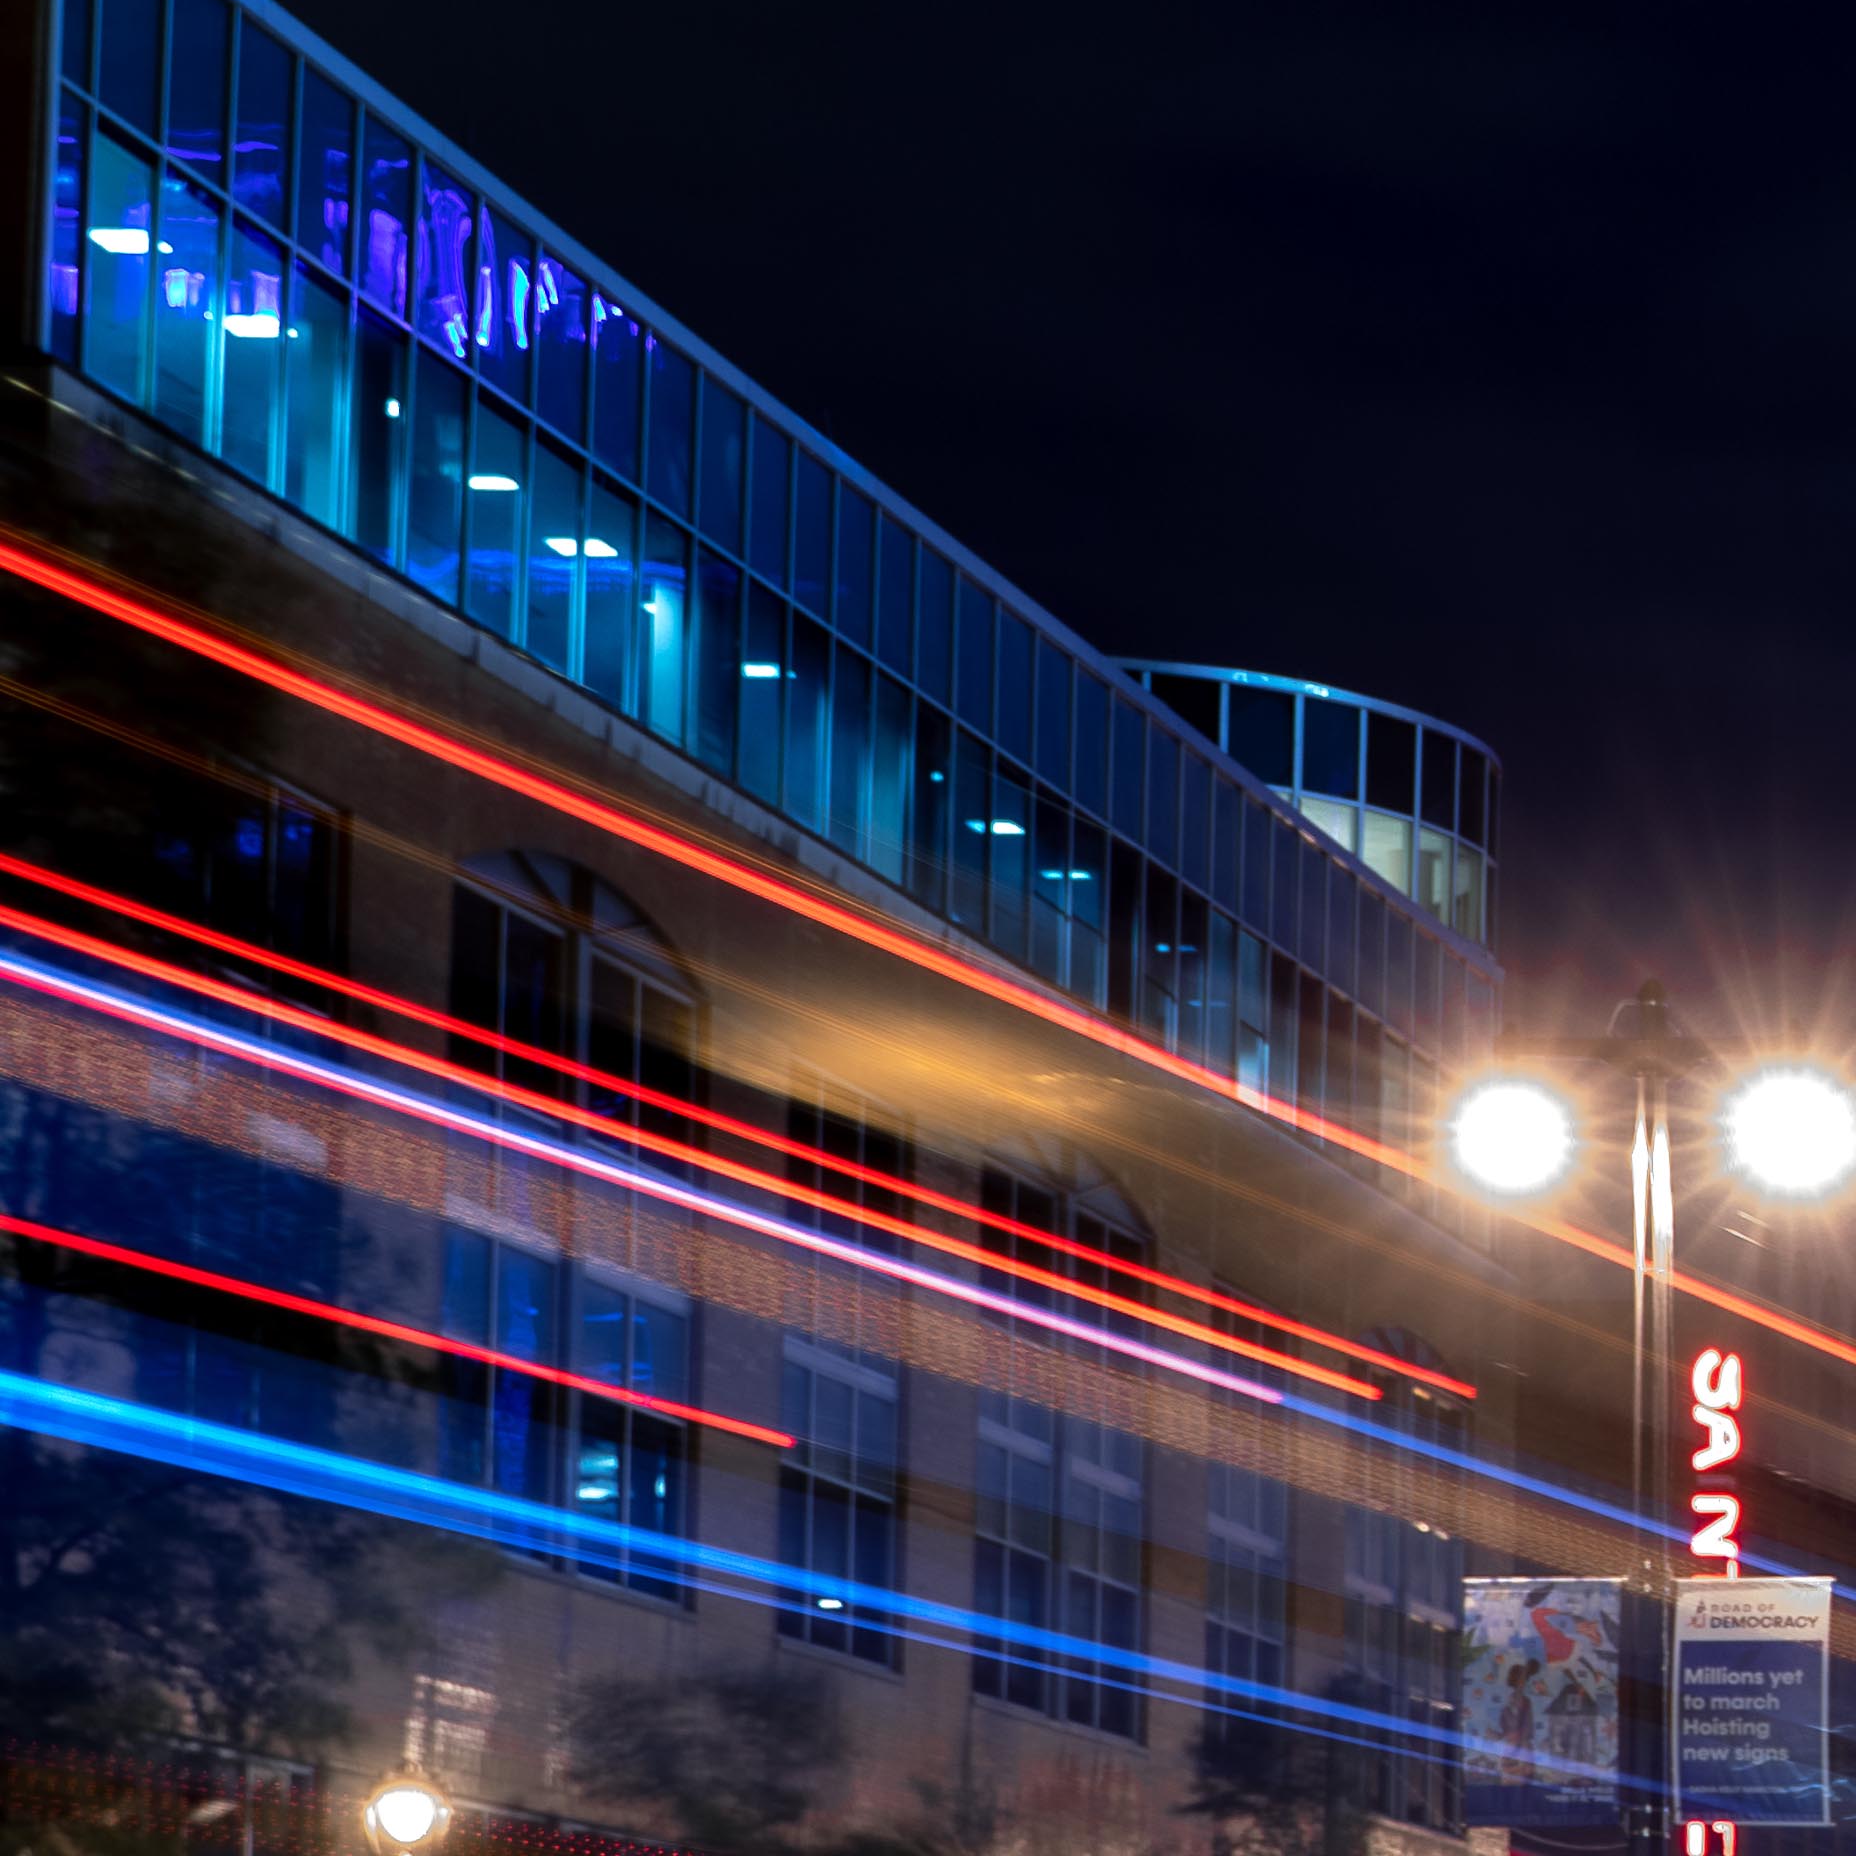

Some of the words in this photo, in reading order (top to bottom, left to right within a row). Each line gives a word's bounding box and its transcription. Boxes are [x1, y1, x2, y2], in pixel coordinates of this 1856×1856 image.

[1757, 1603, 1776, 1612] OF
[1710, 1616, 1818, 1629] DEMOCRACY
[1683, 1667, 1764, 1685] Millions
[1769, 1670, 1803, 1688] yet
[1683, 1694, 1705, 1710] to
[1710, 1693, 1780, 1710] march
[1683, 1718, 1770, 1739] Hoisting
[1683, 1747, 1729, 1760] new
[1735, 1744, 1789, 1765] signs
